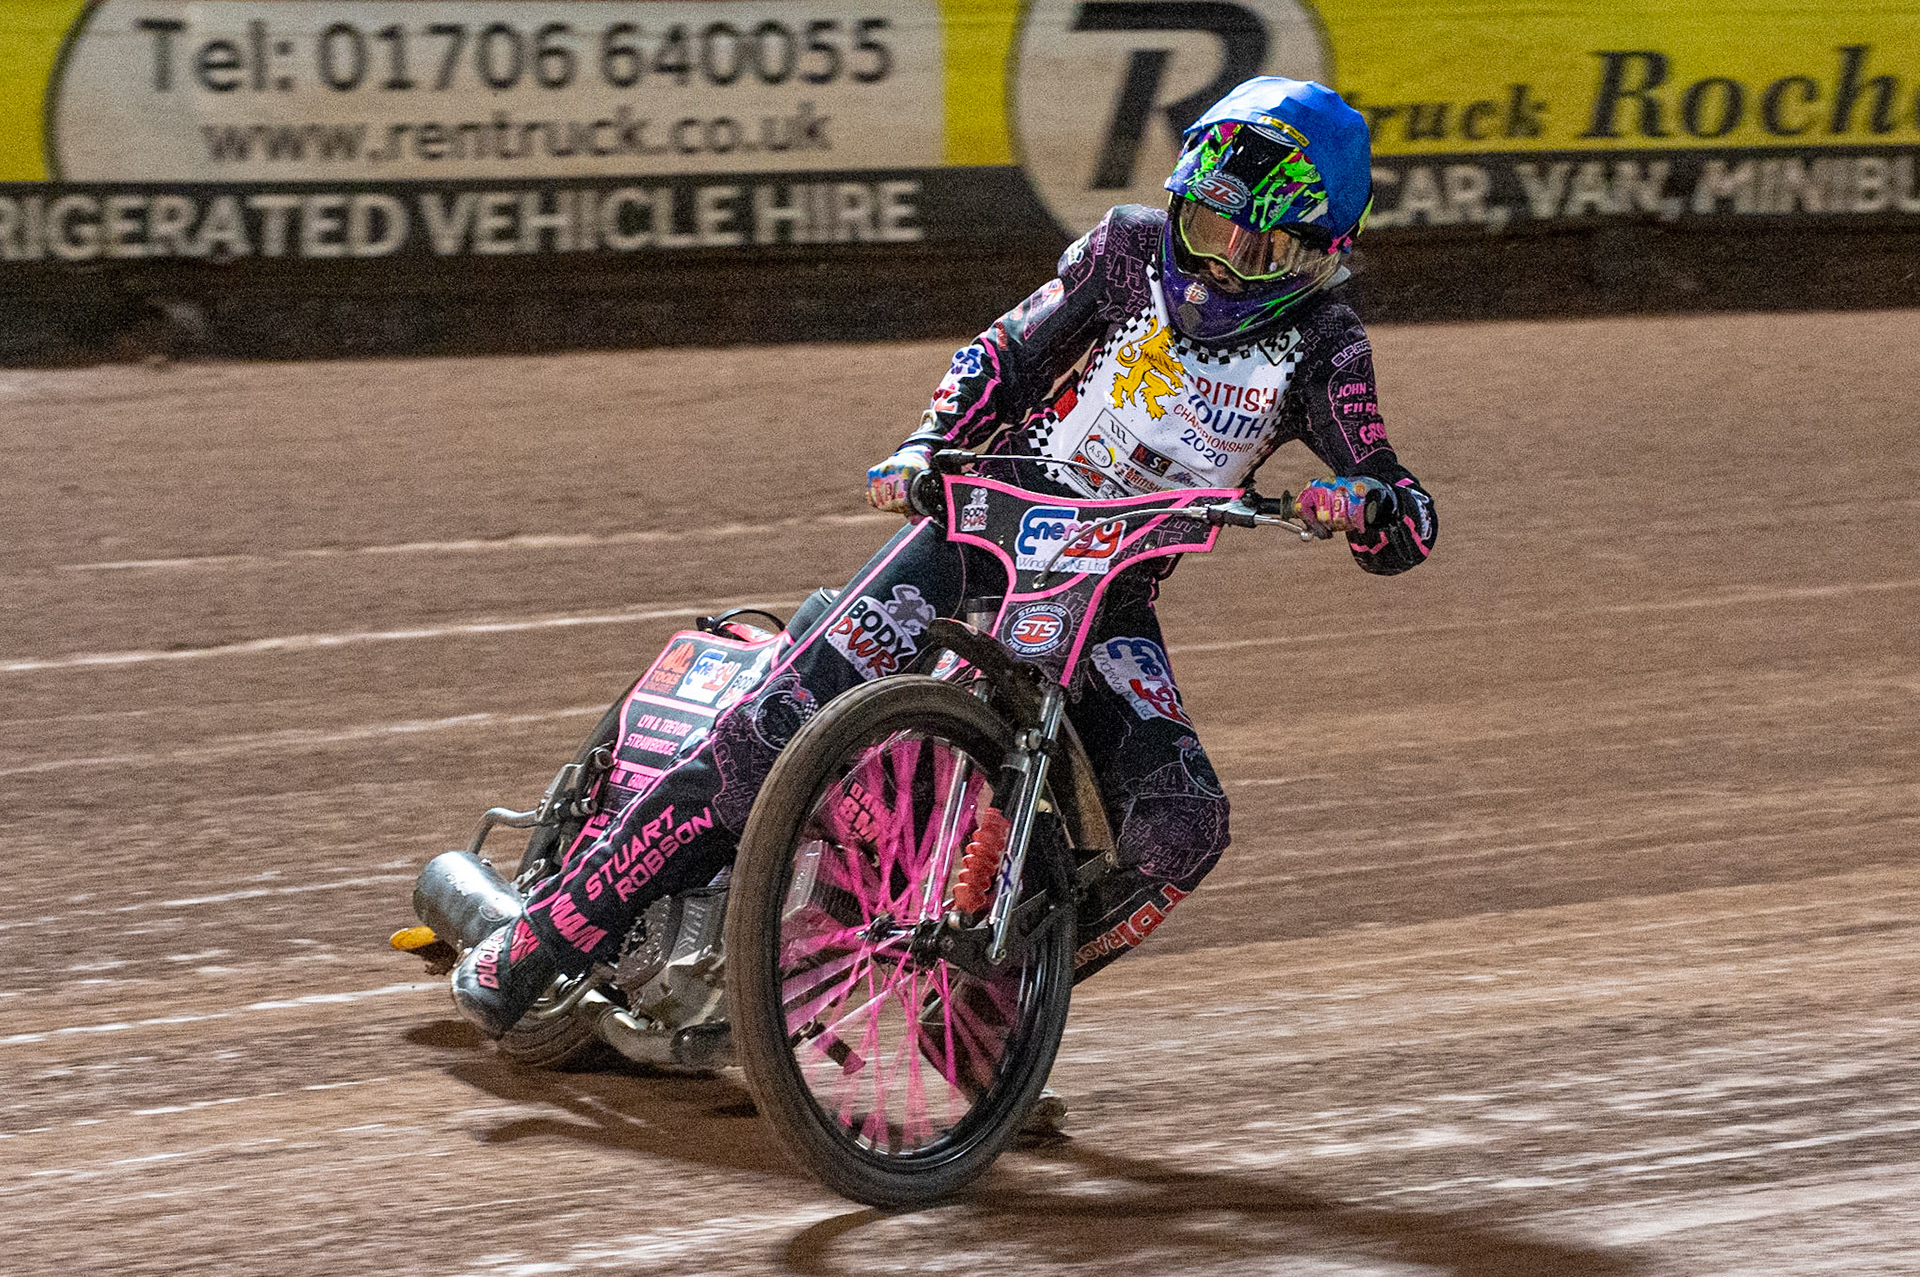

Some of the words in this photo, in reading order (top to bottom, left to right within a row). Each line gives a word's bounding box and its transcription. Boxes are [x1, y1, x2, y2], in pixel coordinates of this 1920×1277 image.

[137, 18, 294, 93] Tel:
[317, 20, 580, 93] 01706
[600, 17, 893, 89] 640055
[1586, 43, 1920, 141] Roch
[203, 101, 831, 166] www.rentruck.co.uk
[1198, 179, 1243, 204] STS
[420, 185, 749, 256] VEHICLE
[756, 182, 923, 247] HIRE
[1264, 331, 1291, 352] 45
[1337, 383, 1367, 398] JOHN
[1172, 403, 1255, 454] CHAMPIONSHIP
[1180, 428, 1229, 468] 2020
[963, 506, 987, 518] BODY
[1017, 508, 1124, 559] Energy
[1088, 559, 1108, 572] Ltd
[847, 599, 914, 657] BODY
[1013, 619, 1060, 637] STS
[1018, 604, 1067, 619] STAKEFORD
[828, 615, 897, 678] PWR
[585, 804, 675, 901] STUART
[614, 806, 714, 903] ROBSON
